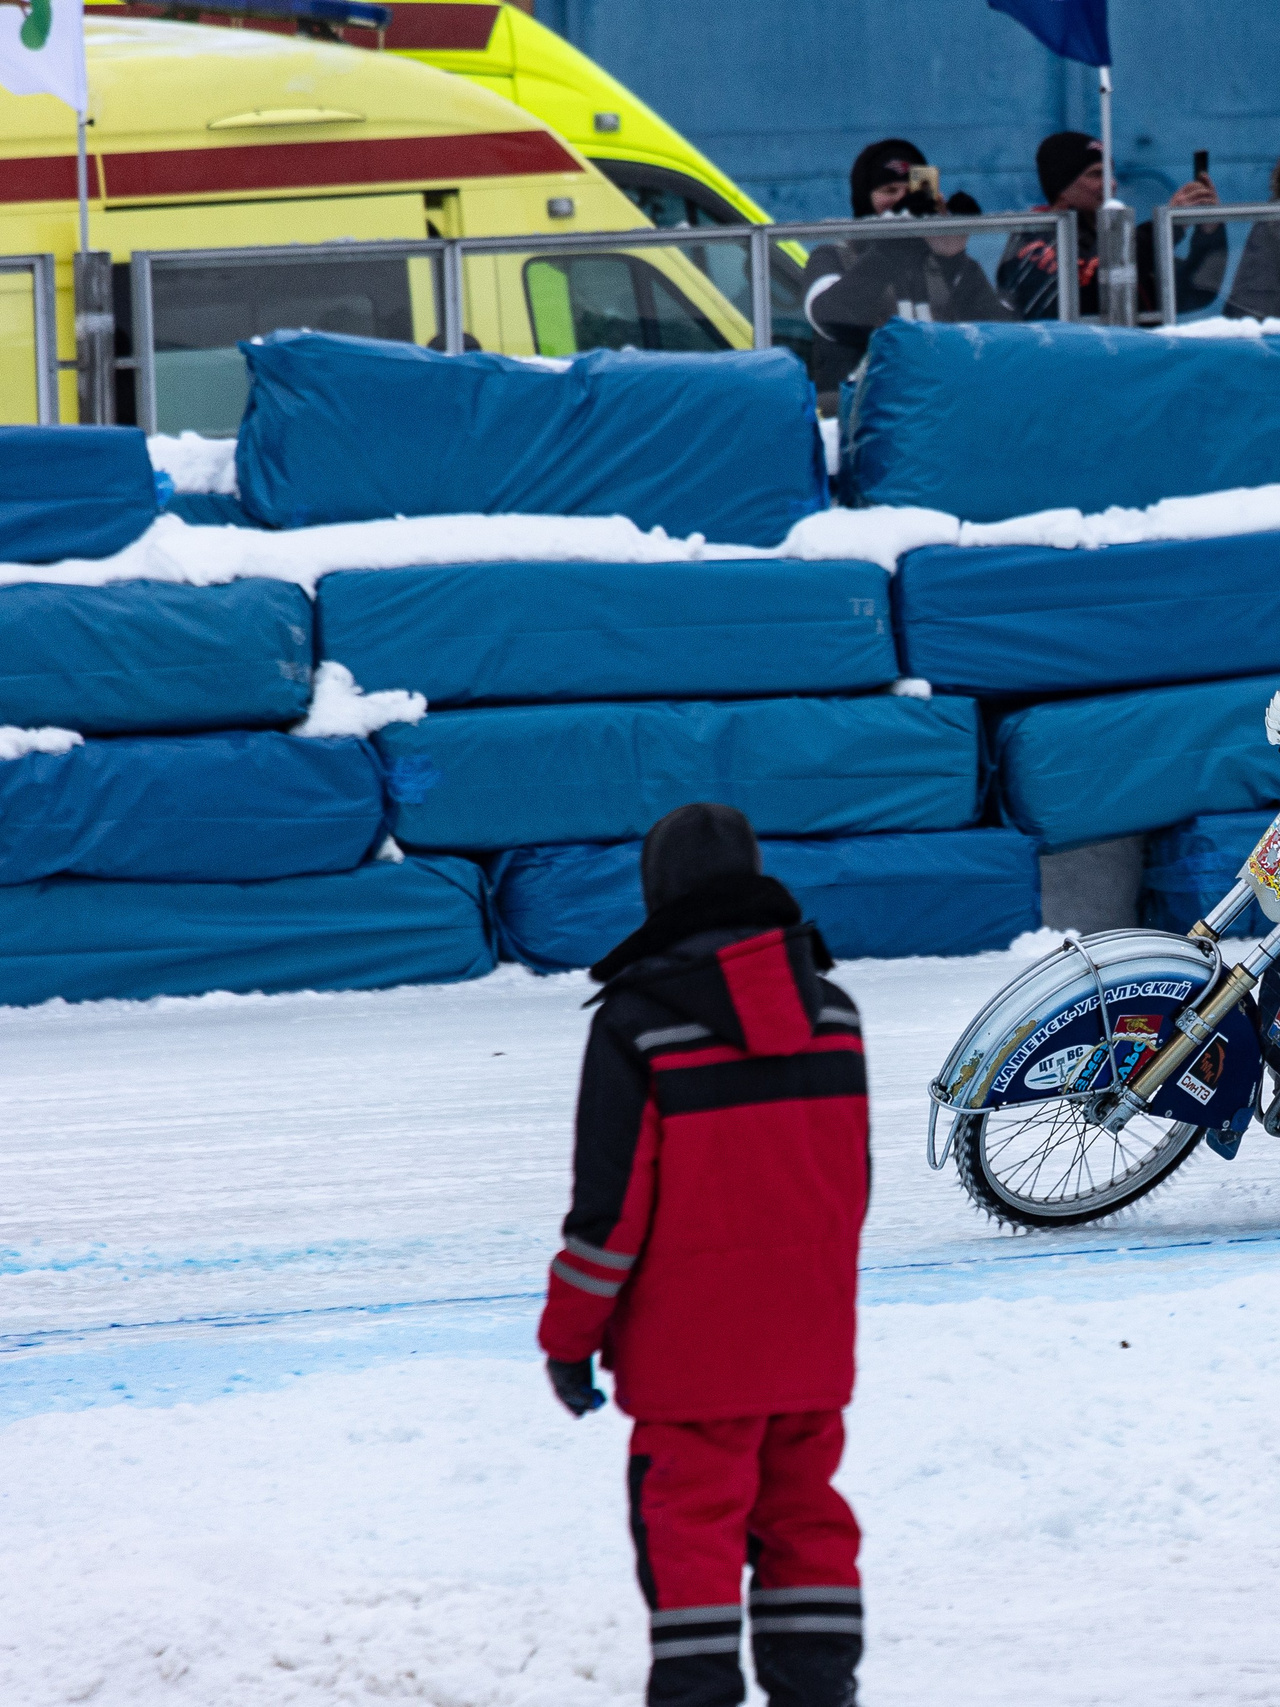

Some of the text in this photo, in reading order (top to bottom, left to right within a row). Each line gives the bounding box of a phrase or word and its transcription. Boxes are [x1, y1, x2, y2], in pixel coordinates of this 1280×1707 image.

[992, 980, 1193, 1094] КАМЕНСК-УРАЛЬСКИЙ
[1038, 1046, 1084, 1073] ЦТ ВС
